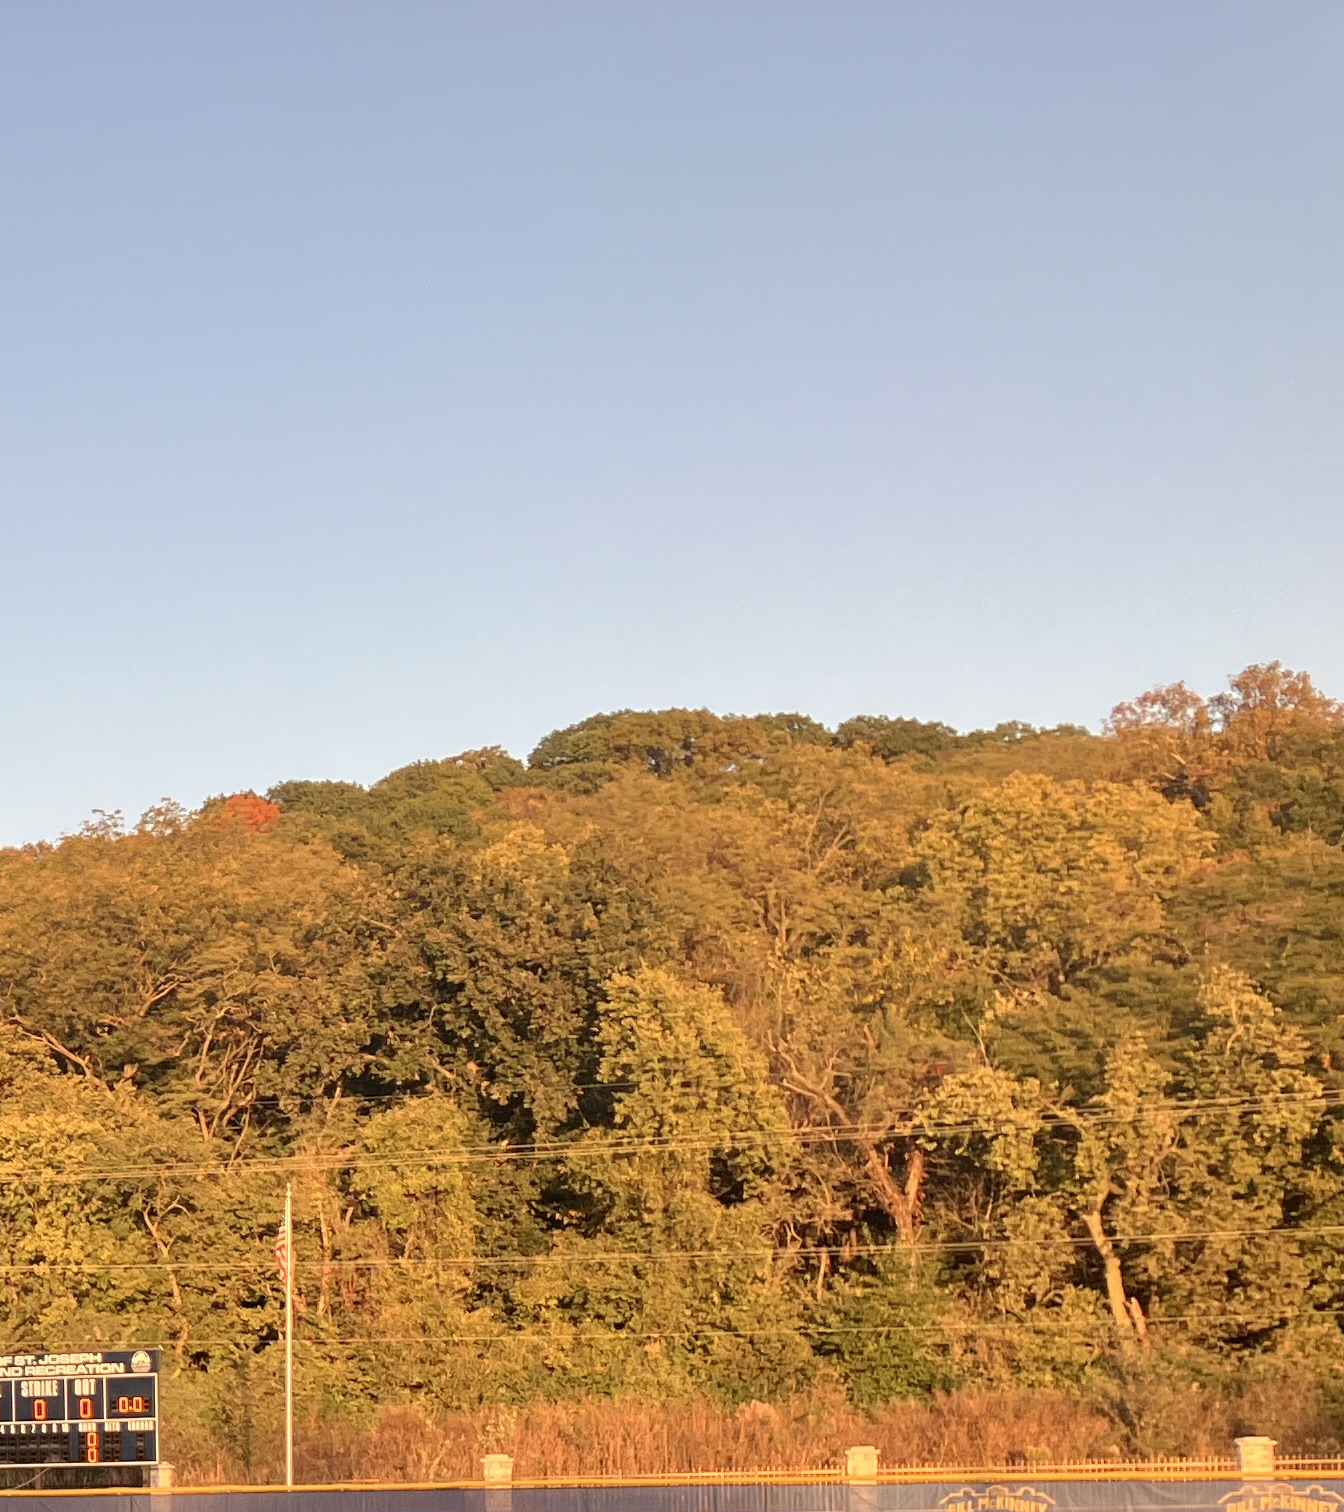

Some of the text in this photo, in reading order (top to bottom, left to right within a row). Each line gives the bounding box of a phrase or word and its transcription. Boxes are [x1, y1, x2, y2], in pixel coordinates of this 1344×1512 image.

[14, 1355, 37, 1366] ST.
[38, 1352, 102, 1365] JOSEPH
[24, 1362, 125, 1376] RECREATION
[21, 1380, 58, 1397] STRIKE
[74, 1379, 96, 1396] OUT
[34, 1399, 47, 1420] 0
[79, 1398, 92, 1419] 0
